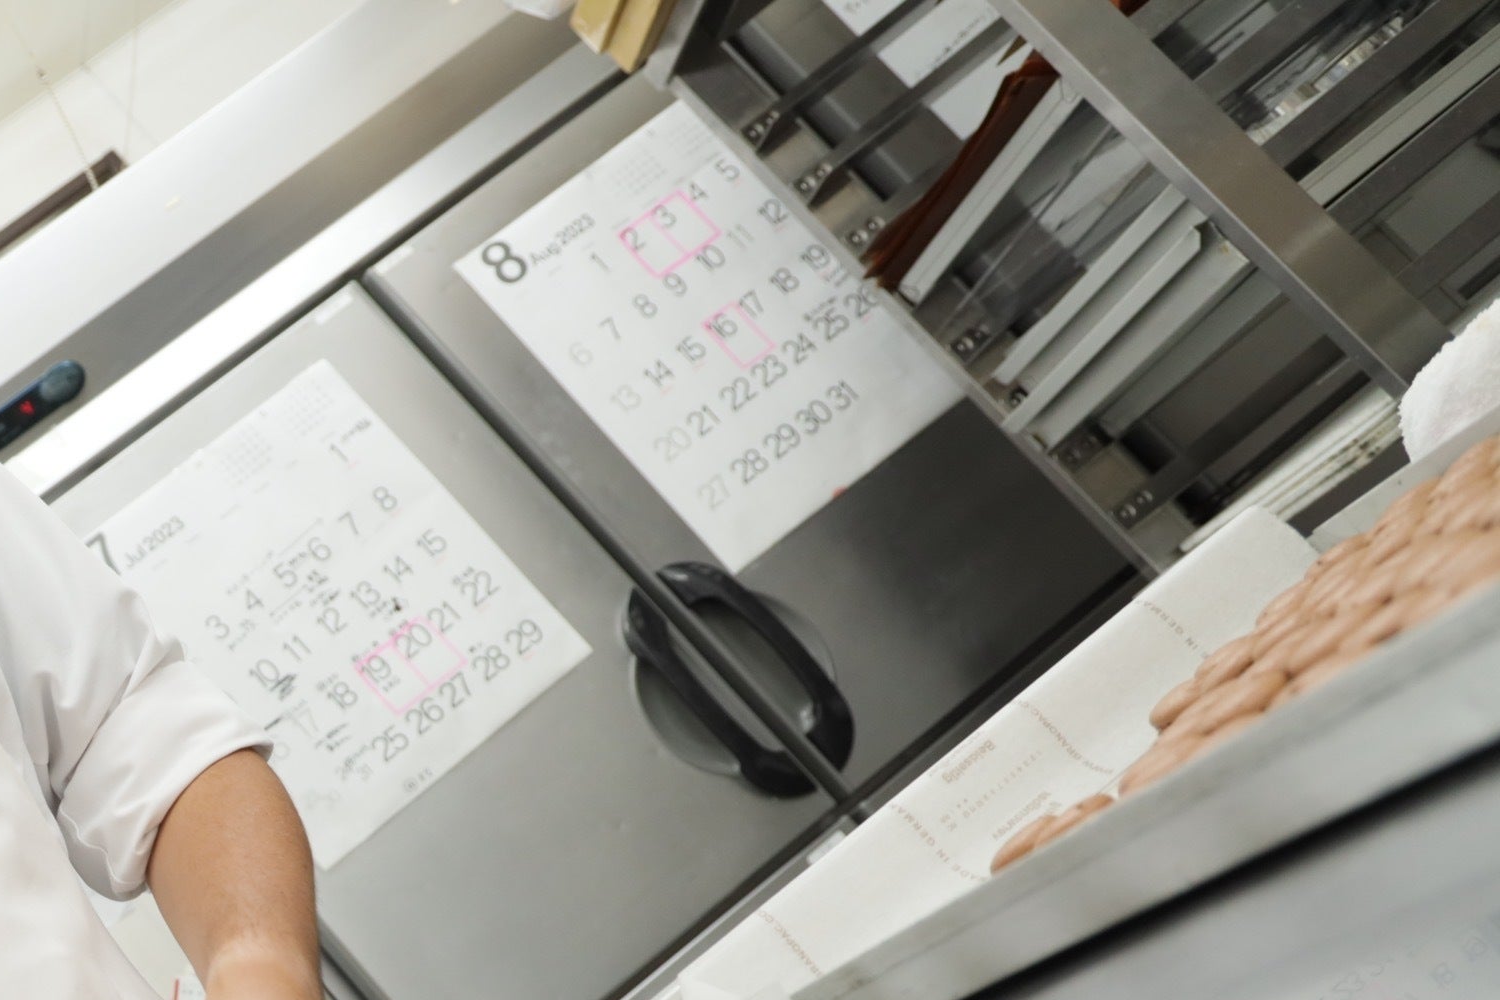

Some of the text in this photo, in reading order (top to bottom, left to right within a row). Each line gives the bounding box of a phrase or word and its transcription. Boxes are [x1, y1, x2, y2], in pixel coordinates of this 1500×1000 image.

[482, 241, 527, 283] 8
[555, 213, 595, 246] 2023
[569, 198, 788, 365] 6 7 8 9 10 11 12
[590, 159, 740, 272] 1 2 3 4 5
[610, 384, 642, 412] 13
[643, 360, 675, 386] 14
[676, 335, 706, 363] 15
[707, 313, 738, 338] 16
[739, 290, 764, 318] 17
[770, 267, 799, 294] 18
[802, 244, 830, 270] 19
[654, 426, 692, 462] 20
[686, 405, 721, 436] 21
[719, 377, 759, 412] 22
[751, 354, 788, 388] 23
[782, 332, 817, 364] 24
[812, 307, 850, 341] 25
[843, 284, 879, 318] 26
[330, 444, 348, 462] 1
[698, 379, 859, 510] 27 28 29 30 31
[85, 515, 185, 575] 7 Jul 2023
[205, 615, 230, 639] 3
[245, 589, 264, 610] 4
[272, 562, 298, 588] 5
[308, 536, 332, 561] 6
[338, 511, 359, 535] 7
[373, 486, 397, 511] 8
[249, 659, 280, 689] 10
[283, 635, 312, 661] 11
[317, 607, 348, 634] 12
[350, 580, 381, 608] 13
[383, 556, 414, 583] 14
[416, 528, 447, 557] 15
[327, 681, 358, 709] 18
[361, 655, 391, 683] 19
[394, 623, 432, 659] 20
[428, 601, 461, 632] 21
[460, 570, 500, 606] 22
[372, 725, 409, 762] 25
[405, 697, 444, 735] 26
[439, 671, 471, 707] 27
[472, 645, 510, 681] 28
[505, 619, 543, 655] 29
